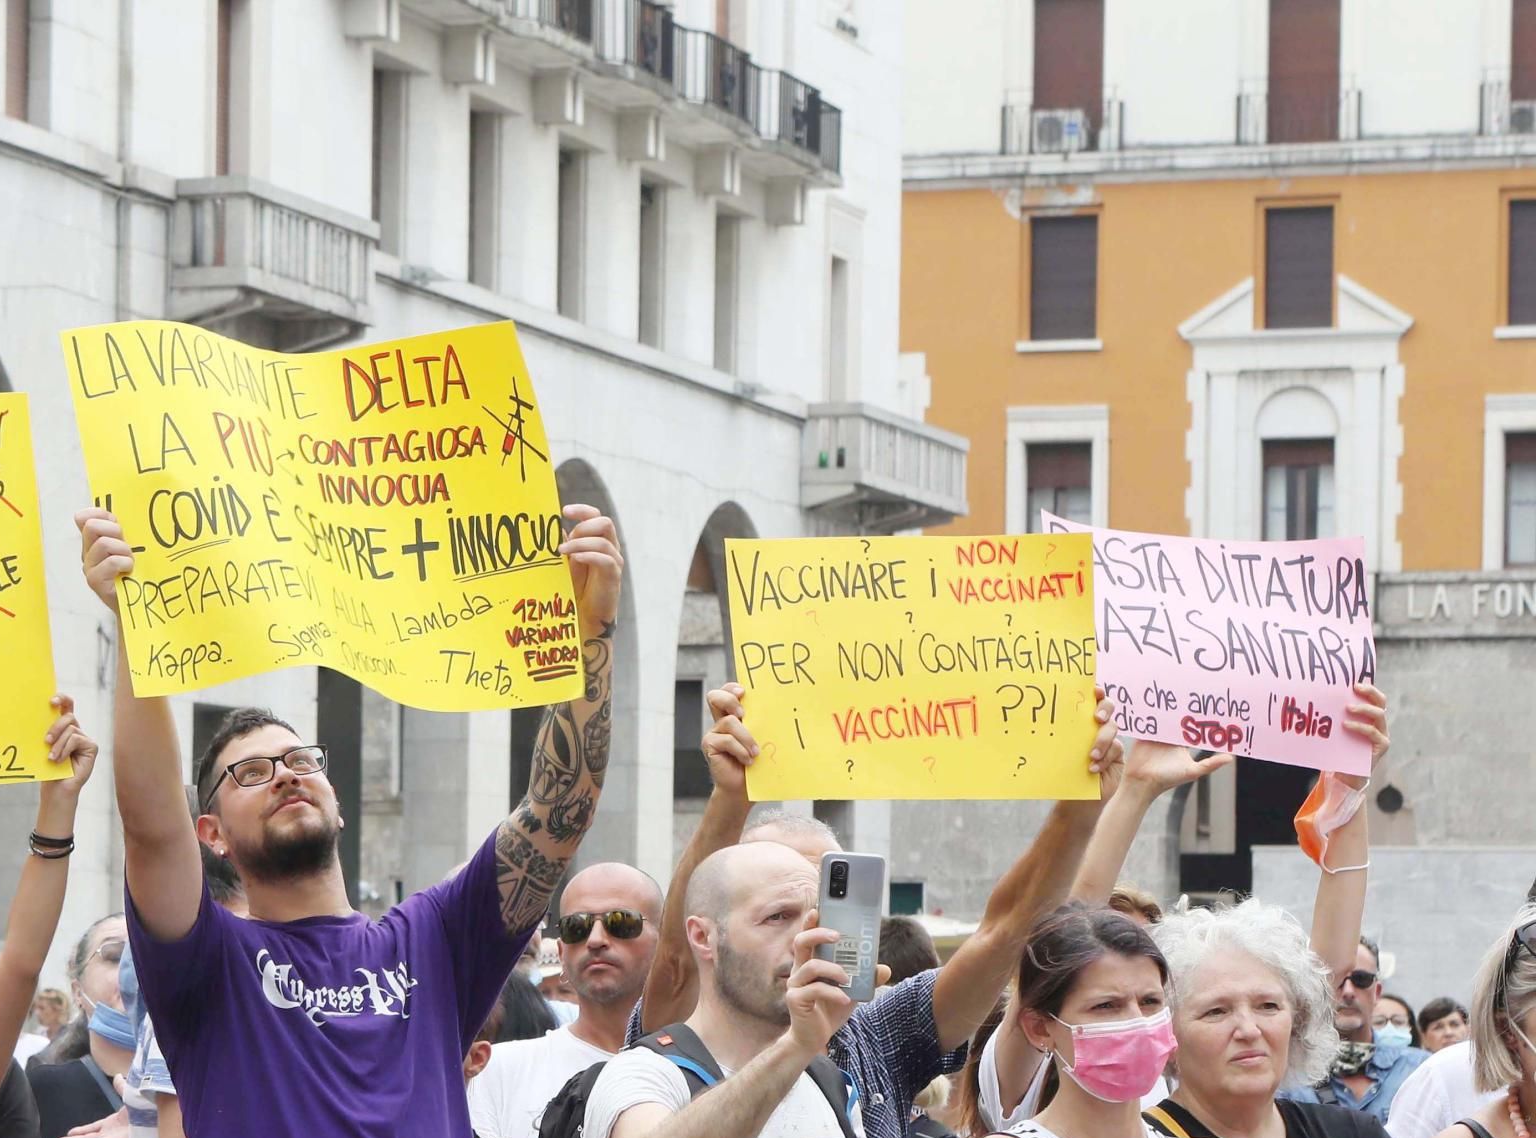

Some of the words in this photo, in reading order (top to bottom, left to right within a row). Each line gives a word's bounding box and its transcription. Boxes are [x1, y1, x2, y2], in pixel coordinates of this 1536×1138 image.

[72, 332, 137, 398] LA
[135, 328, 318, 420] VARIANTE
[342, 344, 470, 423] DELTA
[128, 412, 197, 474] LA
[297, 424, 487, 466] CONTAGIOSA
[317, 473, 450, 508] INNOCUA
[149, 475, 252, 548] COVID
[293, 505, 393, 582] SEMPRE
[447, 508, 563, 575] INNOCUO
[121, 560, 321, 629] PREPARATEVI
[332, 587, 376, 634] ALLA
[731, 551, 907, 615] VACCINARE
[956, 540, 1018, 567] NON
[948, 560, 1086, 605] VACCINATI
[1050, 521, 1185, 596] ASTA
[1195, 544, 1369, 623] DITTATURA
[1407, 583, 1451, 619] LA
[505, 617, 576, 649] VARIANTI
[741, 642, 815, 689] PER
[838, 639, 903, 682] NON
[918, 631, 1096, 676] CONTAGIARE
[832, 696, 978, 744] VACCINATI
[1143, 680, 1177, 711] che
[1188, 688, 1250, 718] anche
